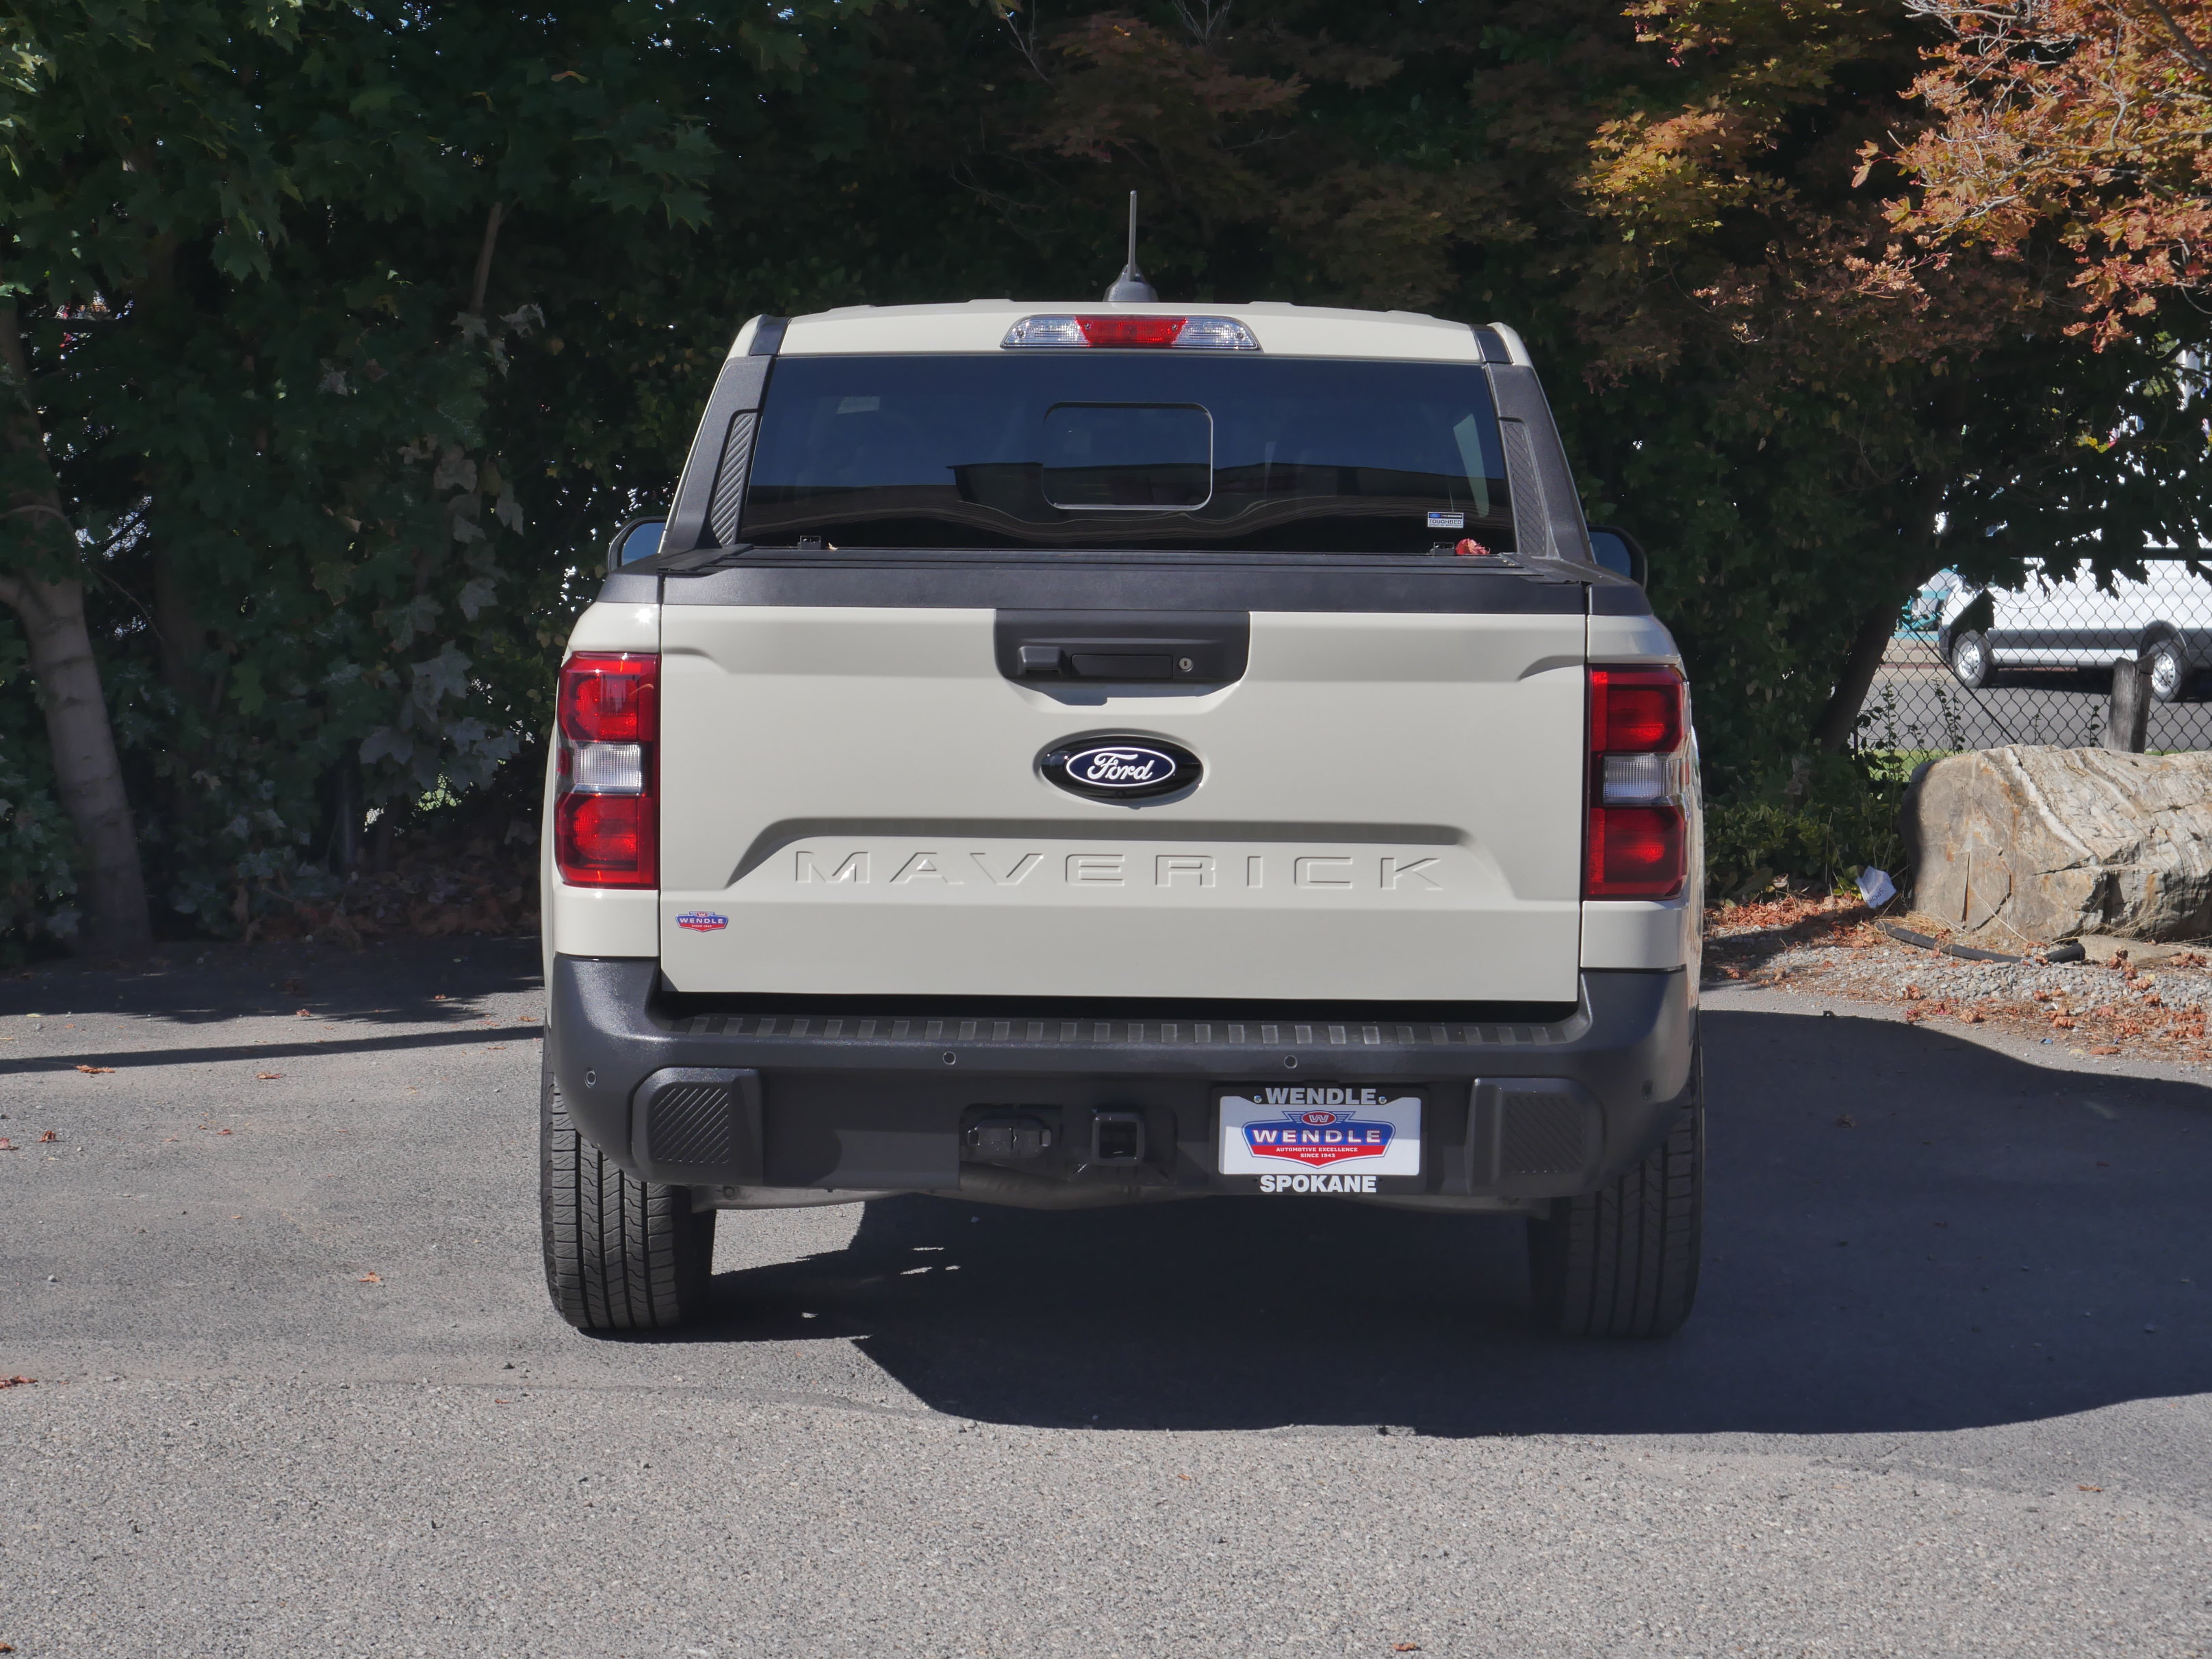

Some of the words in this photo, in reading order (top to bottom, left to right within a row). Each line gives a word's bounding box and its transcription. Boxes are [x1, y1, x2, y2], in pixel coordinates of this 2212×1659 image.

[1087, 752, 1155, 780] Ford
[795, 851, 1443, 890] MAVERICK
[1265, 1088, 1377, 1105] WENDLE
[1252, 1129, 1381, 1144] WENDLE
[1260, 1174, 1377, 1193] SPOKANE
